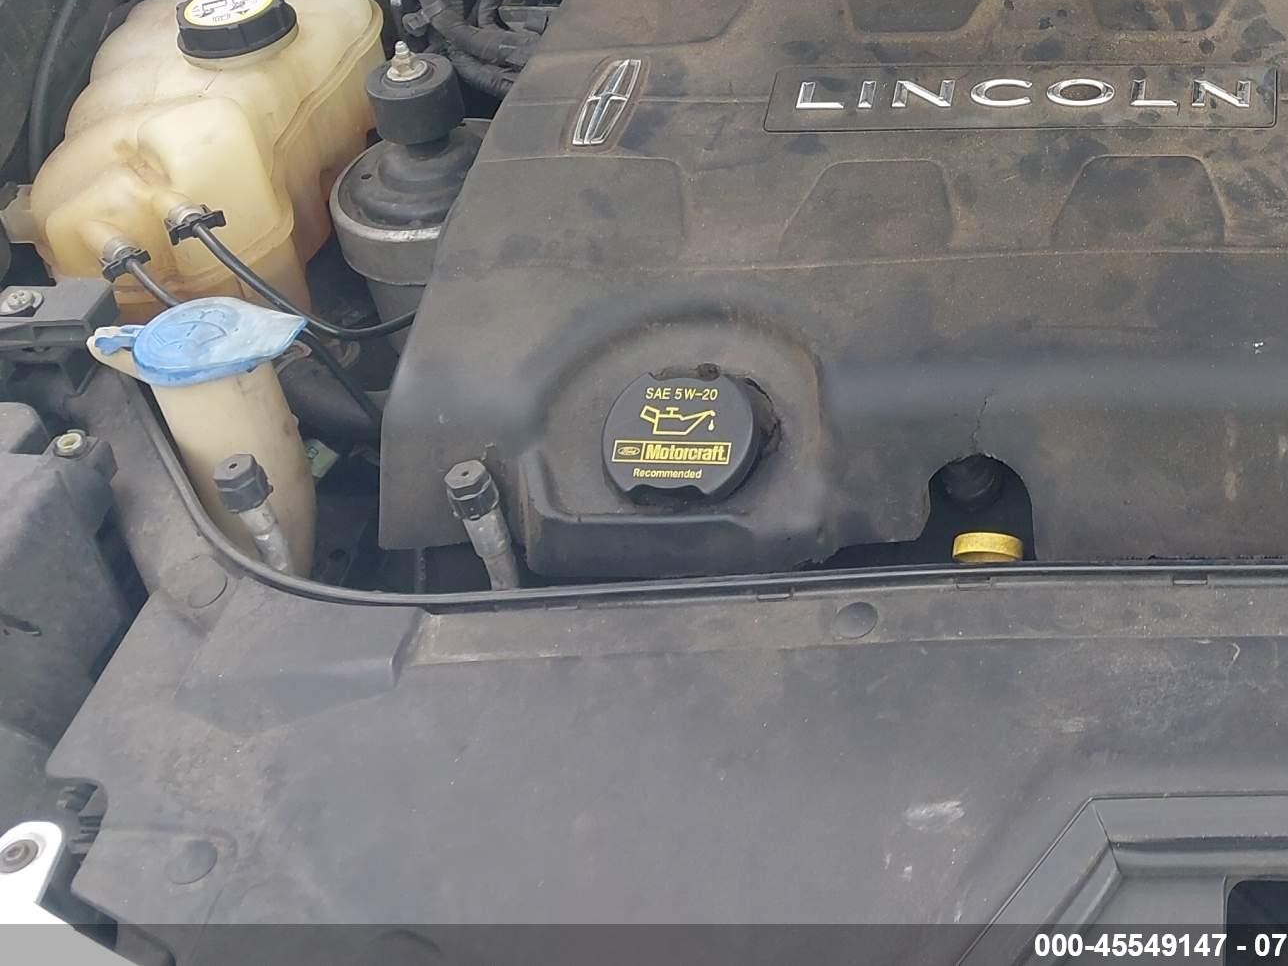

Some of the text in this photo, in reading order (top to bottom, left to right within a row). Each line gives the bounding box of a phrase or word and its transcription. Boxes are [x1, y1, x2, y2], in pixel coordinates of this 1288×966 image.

[795, 78, 1252, 110] LINCOLN
[645, 387, 719, 402] SAE 5W-20
[645, 444, 726, 462] Motorcraft
[632, 467, 703, 480] Recommended
